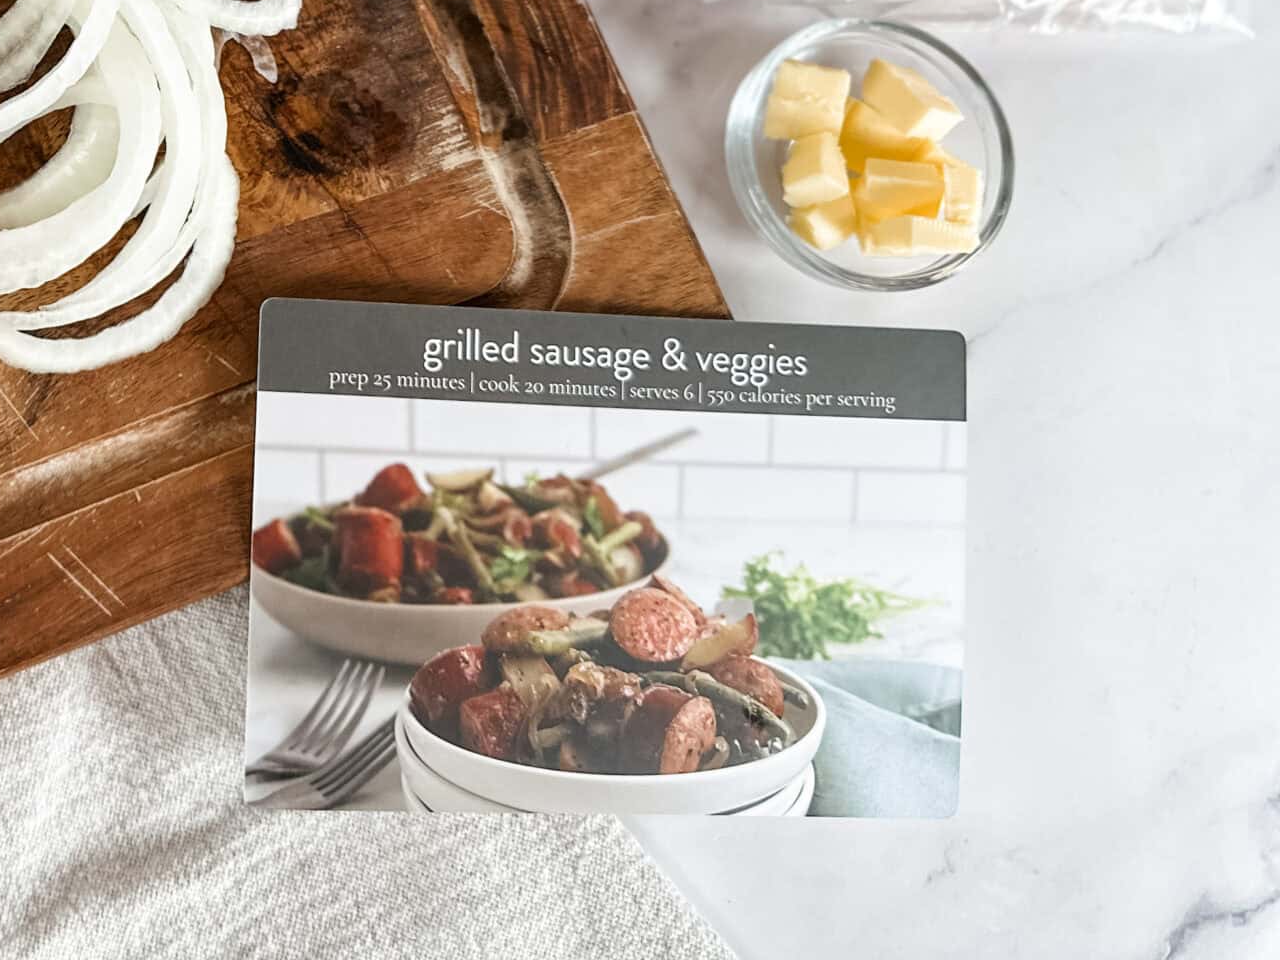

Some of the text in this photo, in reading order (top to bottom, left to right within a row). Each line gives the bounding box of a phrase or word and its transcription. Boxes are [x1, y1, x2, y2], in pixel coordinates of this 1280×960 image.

[423, 328, 808, 386] grilled sausage & veggies
[329, 371, 897, 413] prep 25 minutes cook 20 minutes serves 6 550 calories per serving
